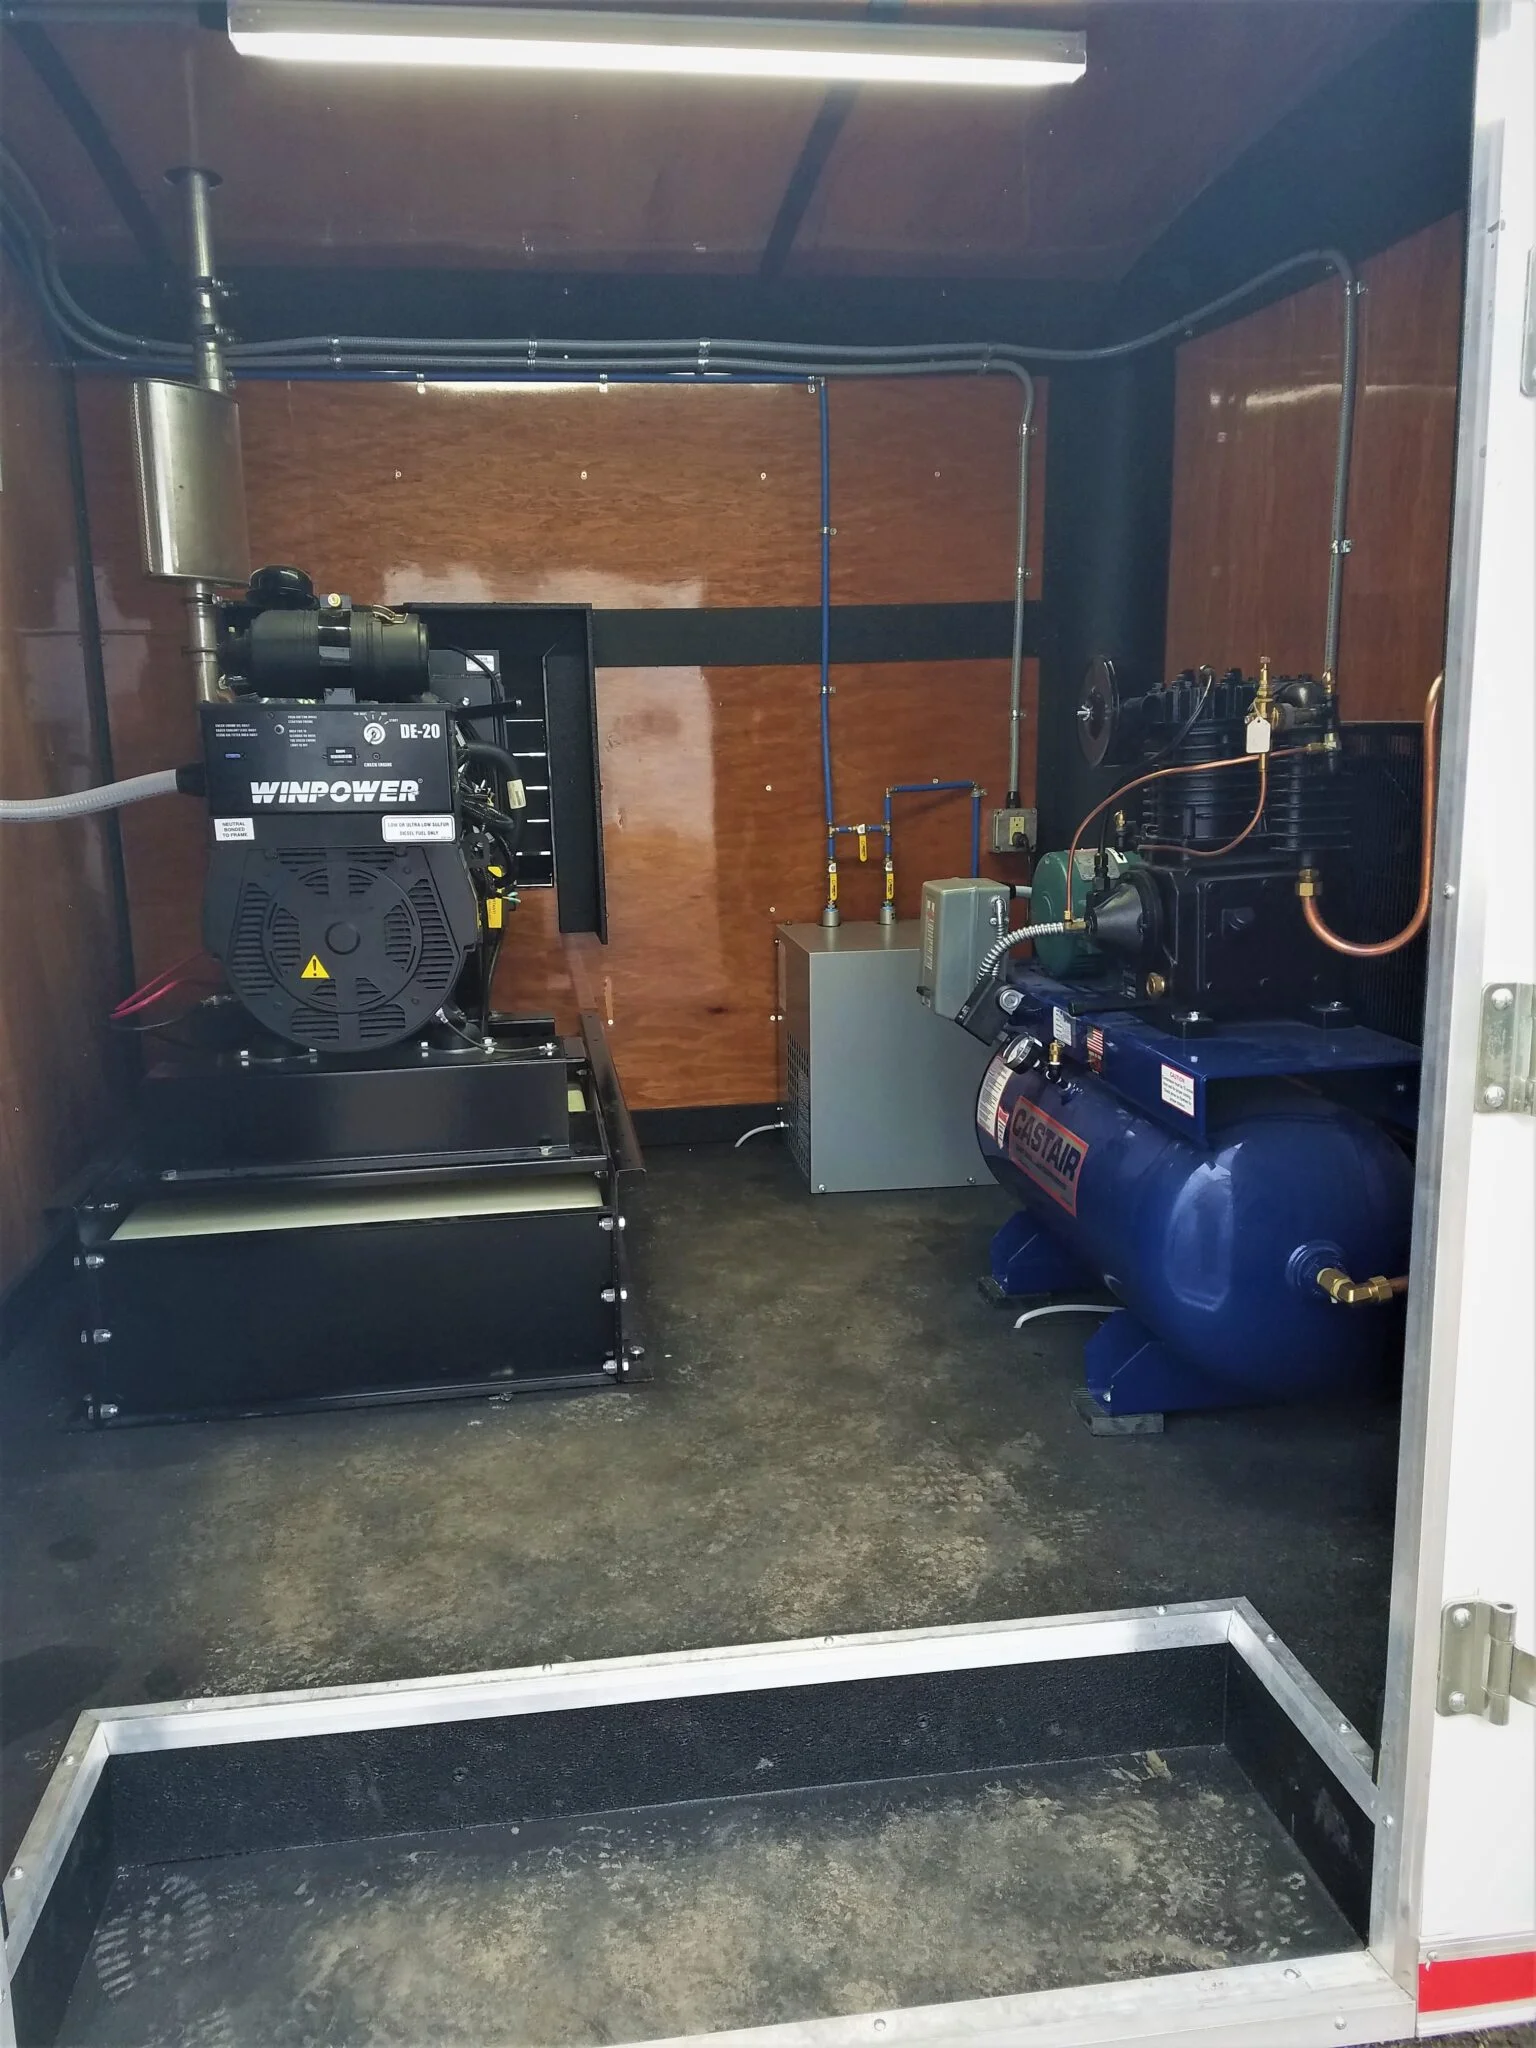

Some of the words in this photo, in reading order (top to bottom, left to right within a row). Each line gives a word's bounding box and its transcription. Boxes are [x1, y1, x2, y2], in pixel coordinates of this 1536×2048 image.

[400, 723, 441, 739] DE-20
[250, 780, 420, 803] WINPOWER
[1169, 1071, 1185, 1084] CAUTION
[1012, 1108, 1082, 1182] CASTAIR
